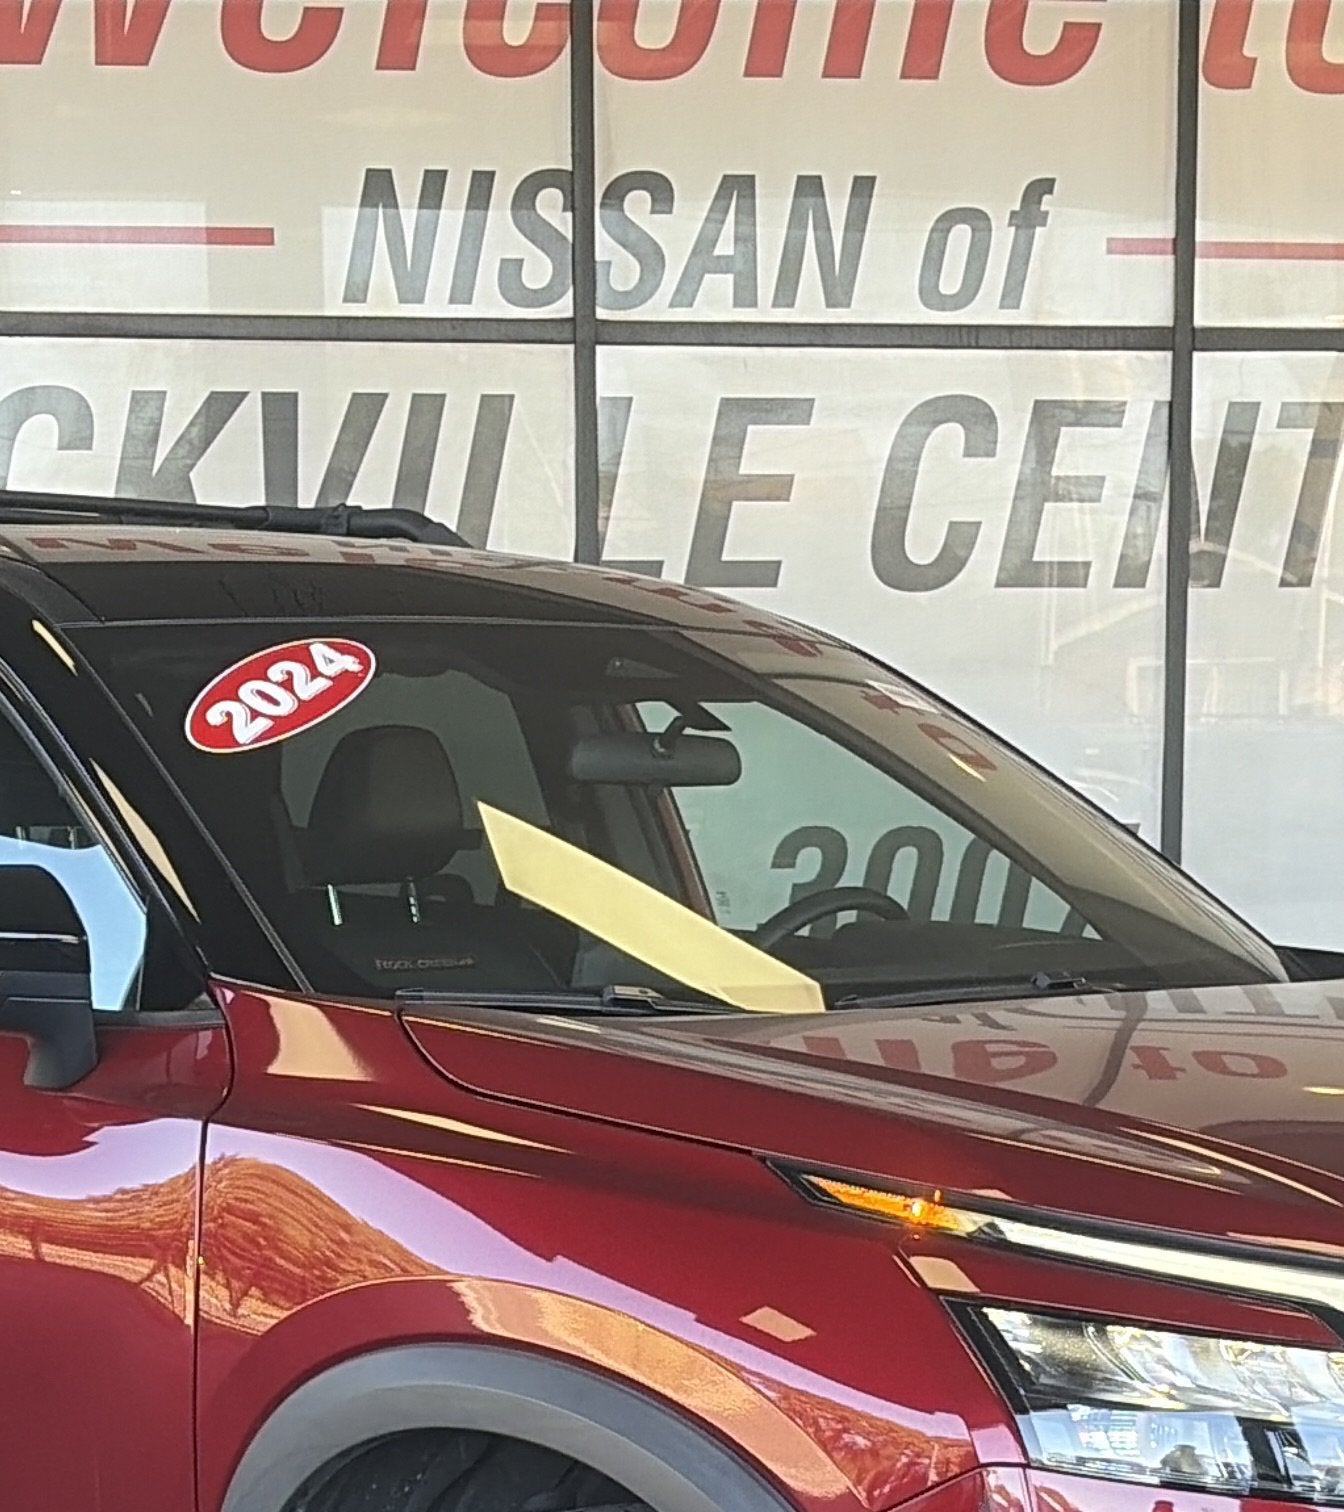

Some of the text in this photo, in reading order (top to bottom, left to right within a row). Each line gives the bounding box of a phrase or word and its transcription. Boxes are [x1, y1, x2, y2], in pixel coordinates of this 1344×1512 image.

[341, 166, 1057, 313] NISSAN of
[205, 642, 365, 745] 2024
